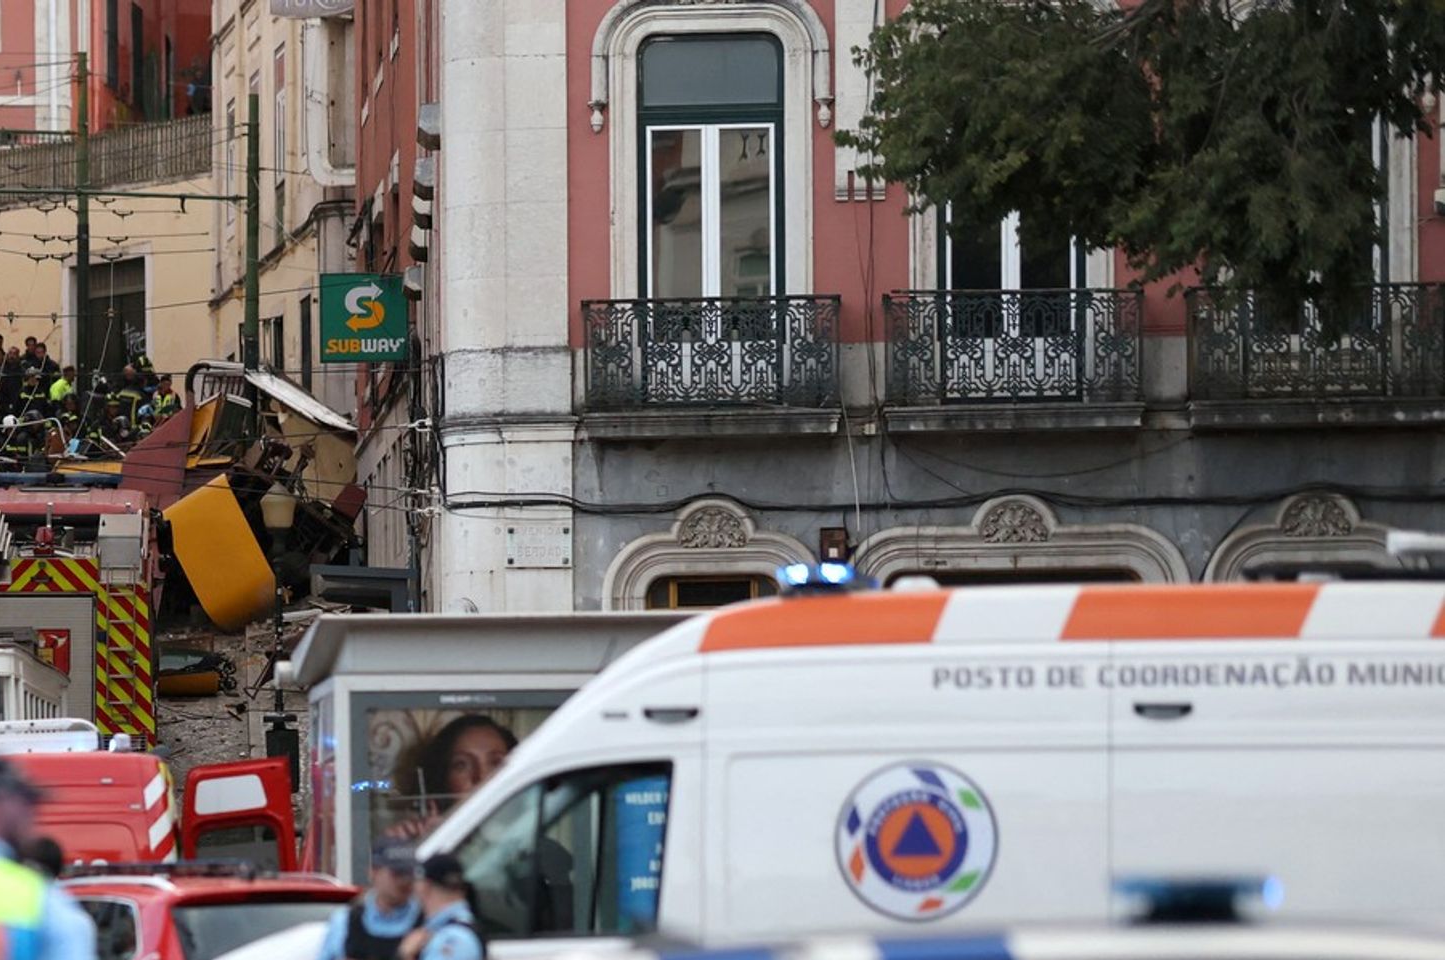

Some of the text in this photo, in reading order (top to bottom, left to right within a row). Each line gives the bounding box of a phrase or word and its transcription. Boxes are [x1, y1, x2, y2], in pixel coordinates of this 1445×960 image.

[324, 337, 405, 354] SUBWAY
[932, 665, 1035, 689] POSTO
[1046, 665, 1086, 688] DE
[1097, 656, 1336, 689] COORDENAÇÃO
